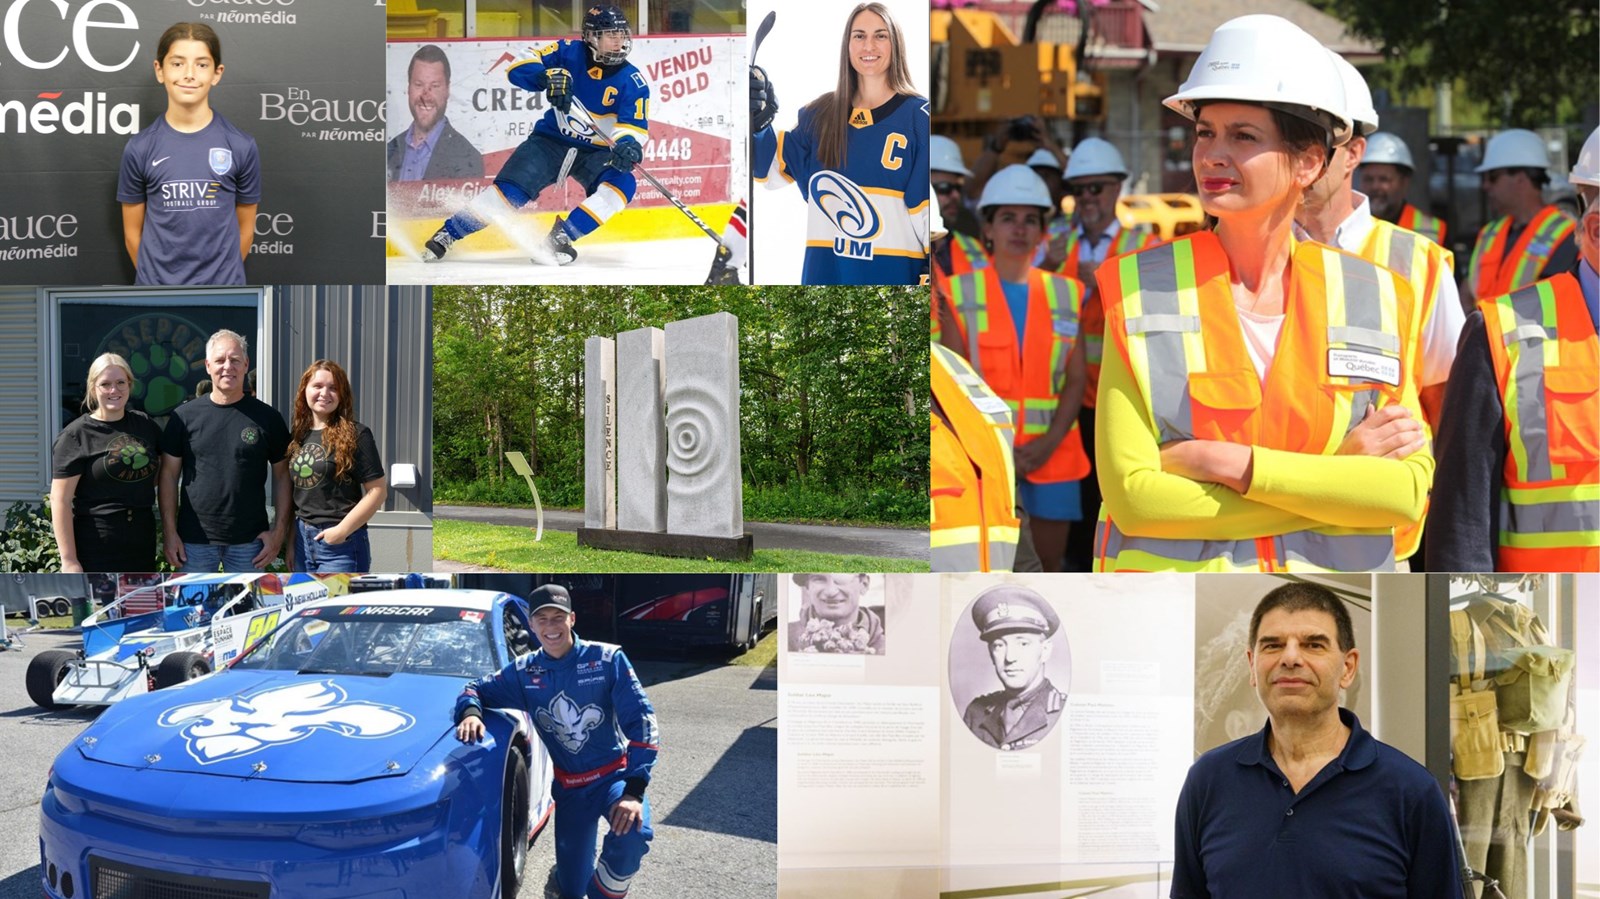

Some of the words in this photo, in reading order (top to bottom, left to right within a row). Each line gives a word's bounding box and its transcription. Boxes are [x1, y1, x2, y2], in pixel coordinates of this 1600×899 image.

[646, 45, 712, 81] VENDU
[288, 87, 310, 100] En
[602, 86, 618, 106] C
[660, 71, 709, 103] SOLD
[644, 137, 692, 161] 4448
[881, 132, 908, 170] C
[161, 182, 221, 199] STRIVE
[419, 184, 455, 201] Alex
[1346, 362, 1380, 374] Québec
[360, 606, 434, 616] NASCAR
